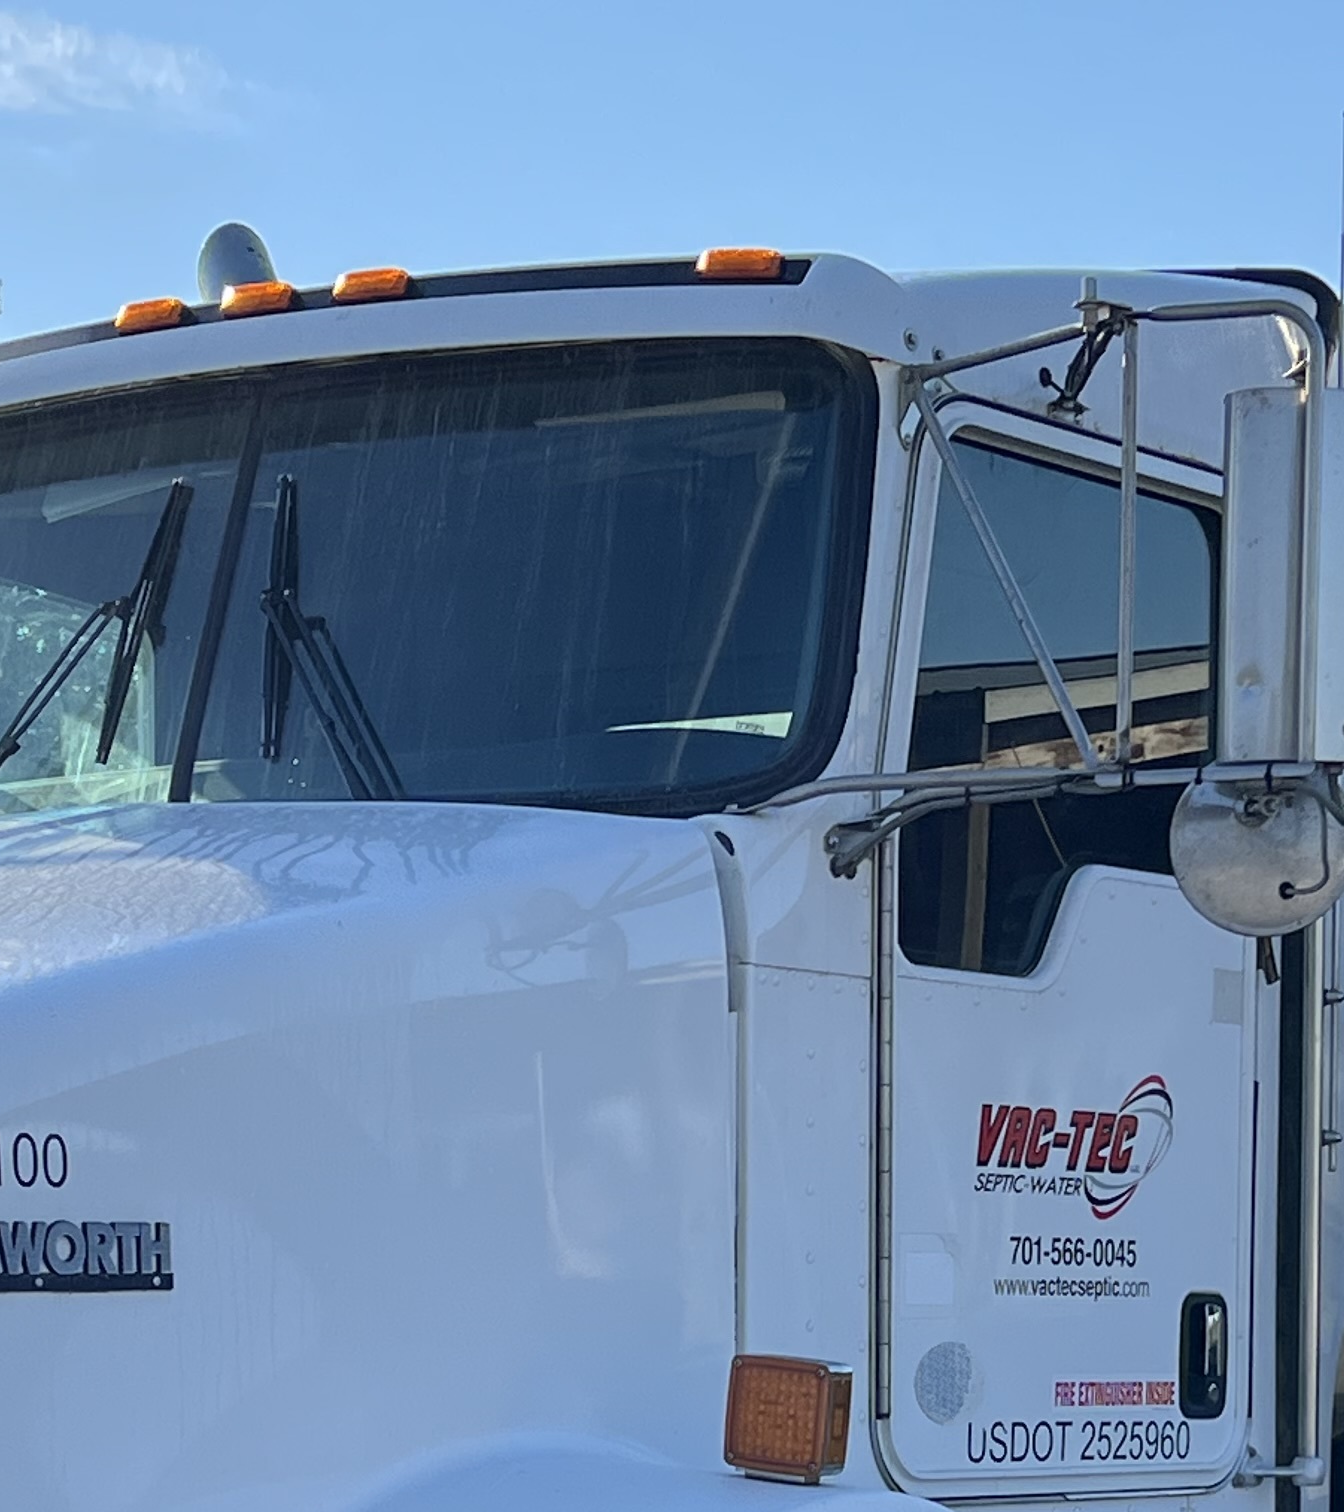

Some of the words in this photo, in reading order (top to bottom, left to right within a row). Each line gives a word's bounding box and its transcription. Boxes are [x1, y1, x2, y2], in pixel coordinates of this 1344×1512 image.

[976, 1103, 1139, 1174] VAC-TEC
[1009, 1235, 1137, 1268] 701-566-0045
[993, 1275, 1151, 1302] www.vactecseptic.com
[1055, 1381, 1076, 1407] FIRE
[1145, 1380, 1176, 1406] INSIDE
[967, 1420, 1074, 1464] USDOT
[1079, 1419, 1191, 1461] 2525960
